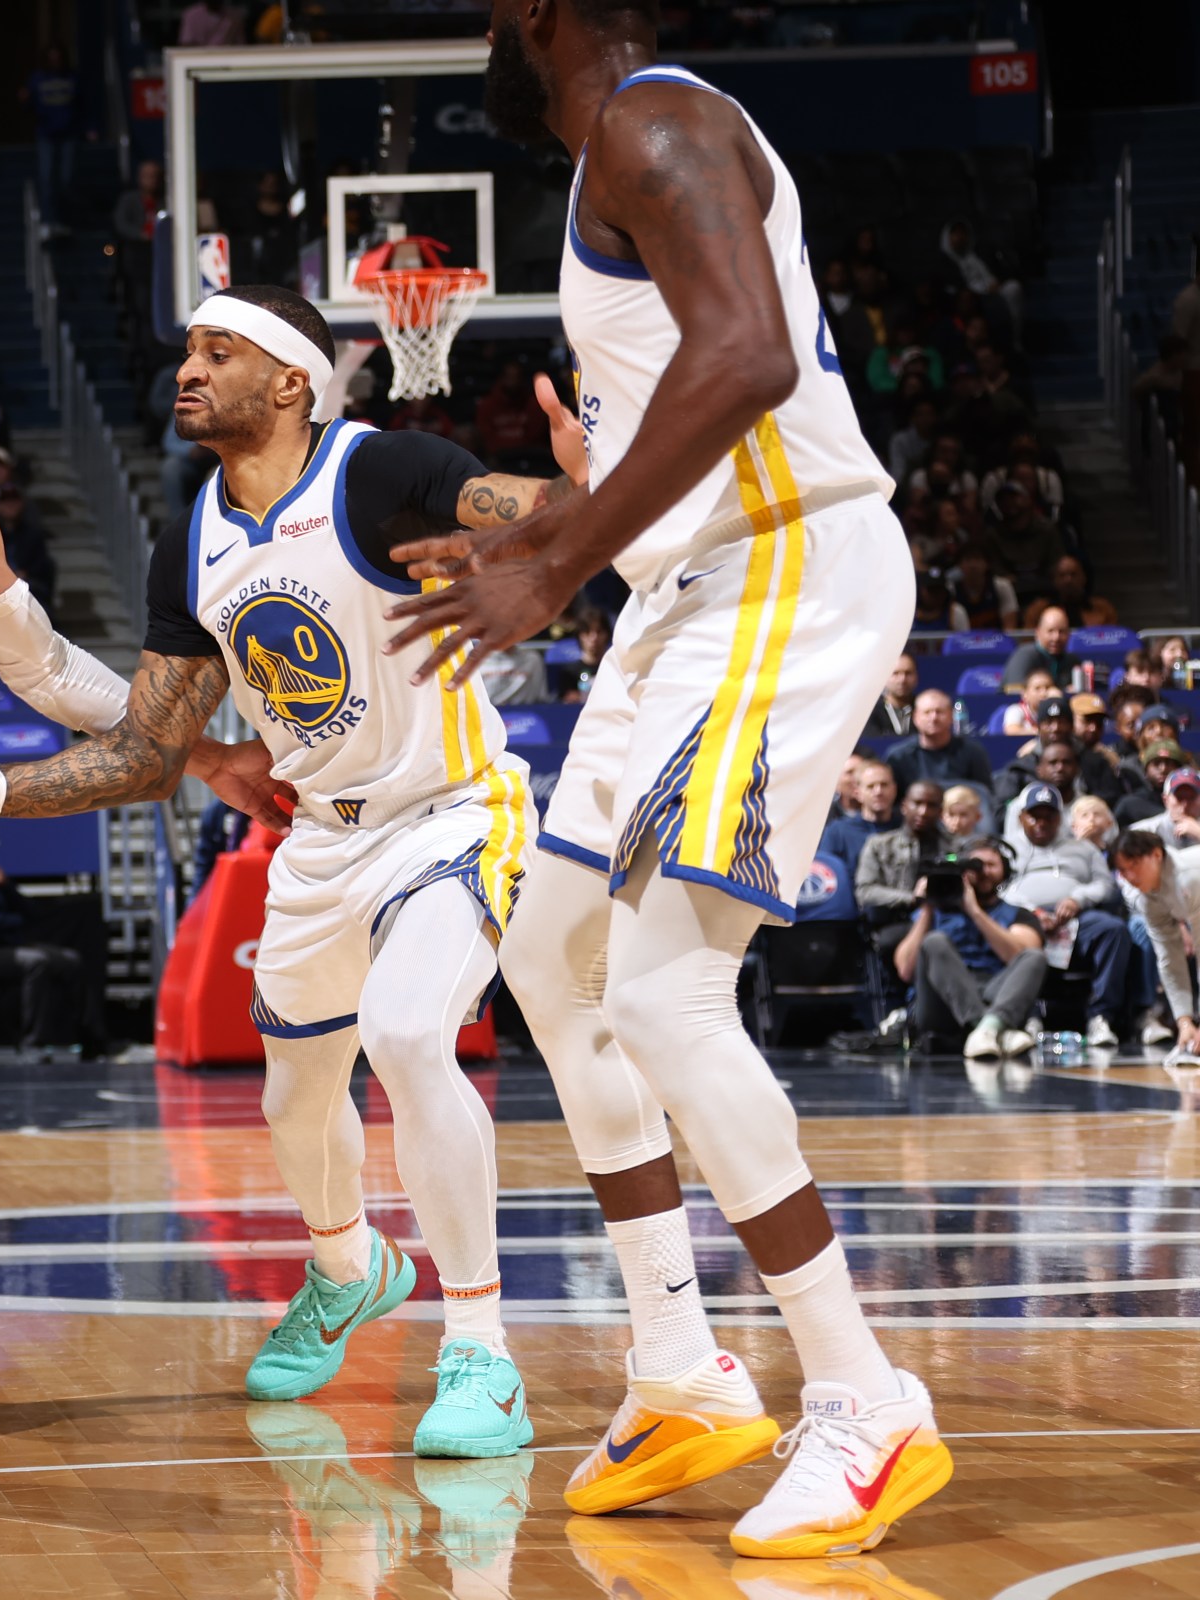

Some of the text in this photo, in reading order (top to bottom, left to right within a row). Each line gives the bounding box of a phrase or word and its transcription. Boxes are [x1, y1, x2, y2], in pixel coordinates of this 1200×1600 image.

[980, 61, 1028, 88] 105
[280, 516, 329, 537] Rakuten
[217, 577, 331, 633] GOLDEN STATE
[294, 625, 318, 662] 0
